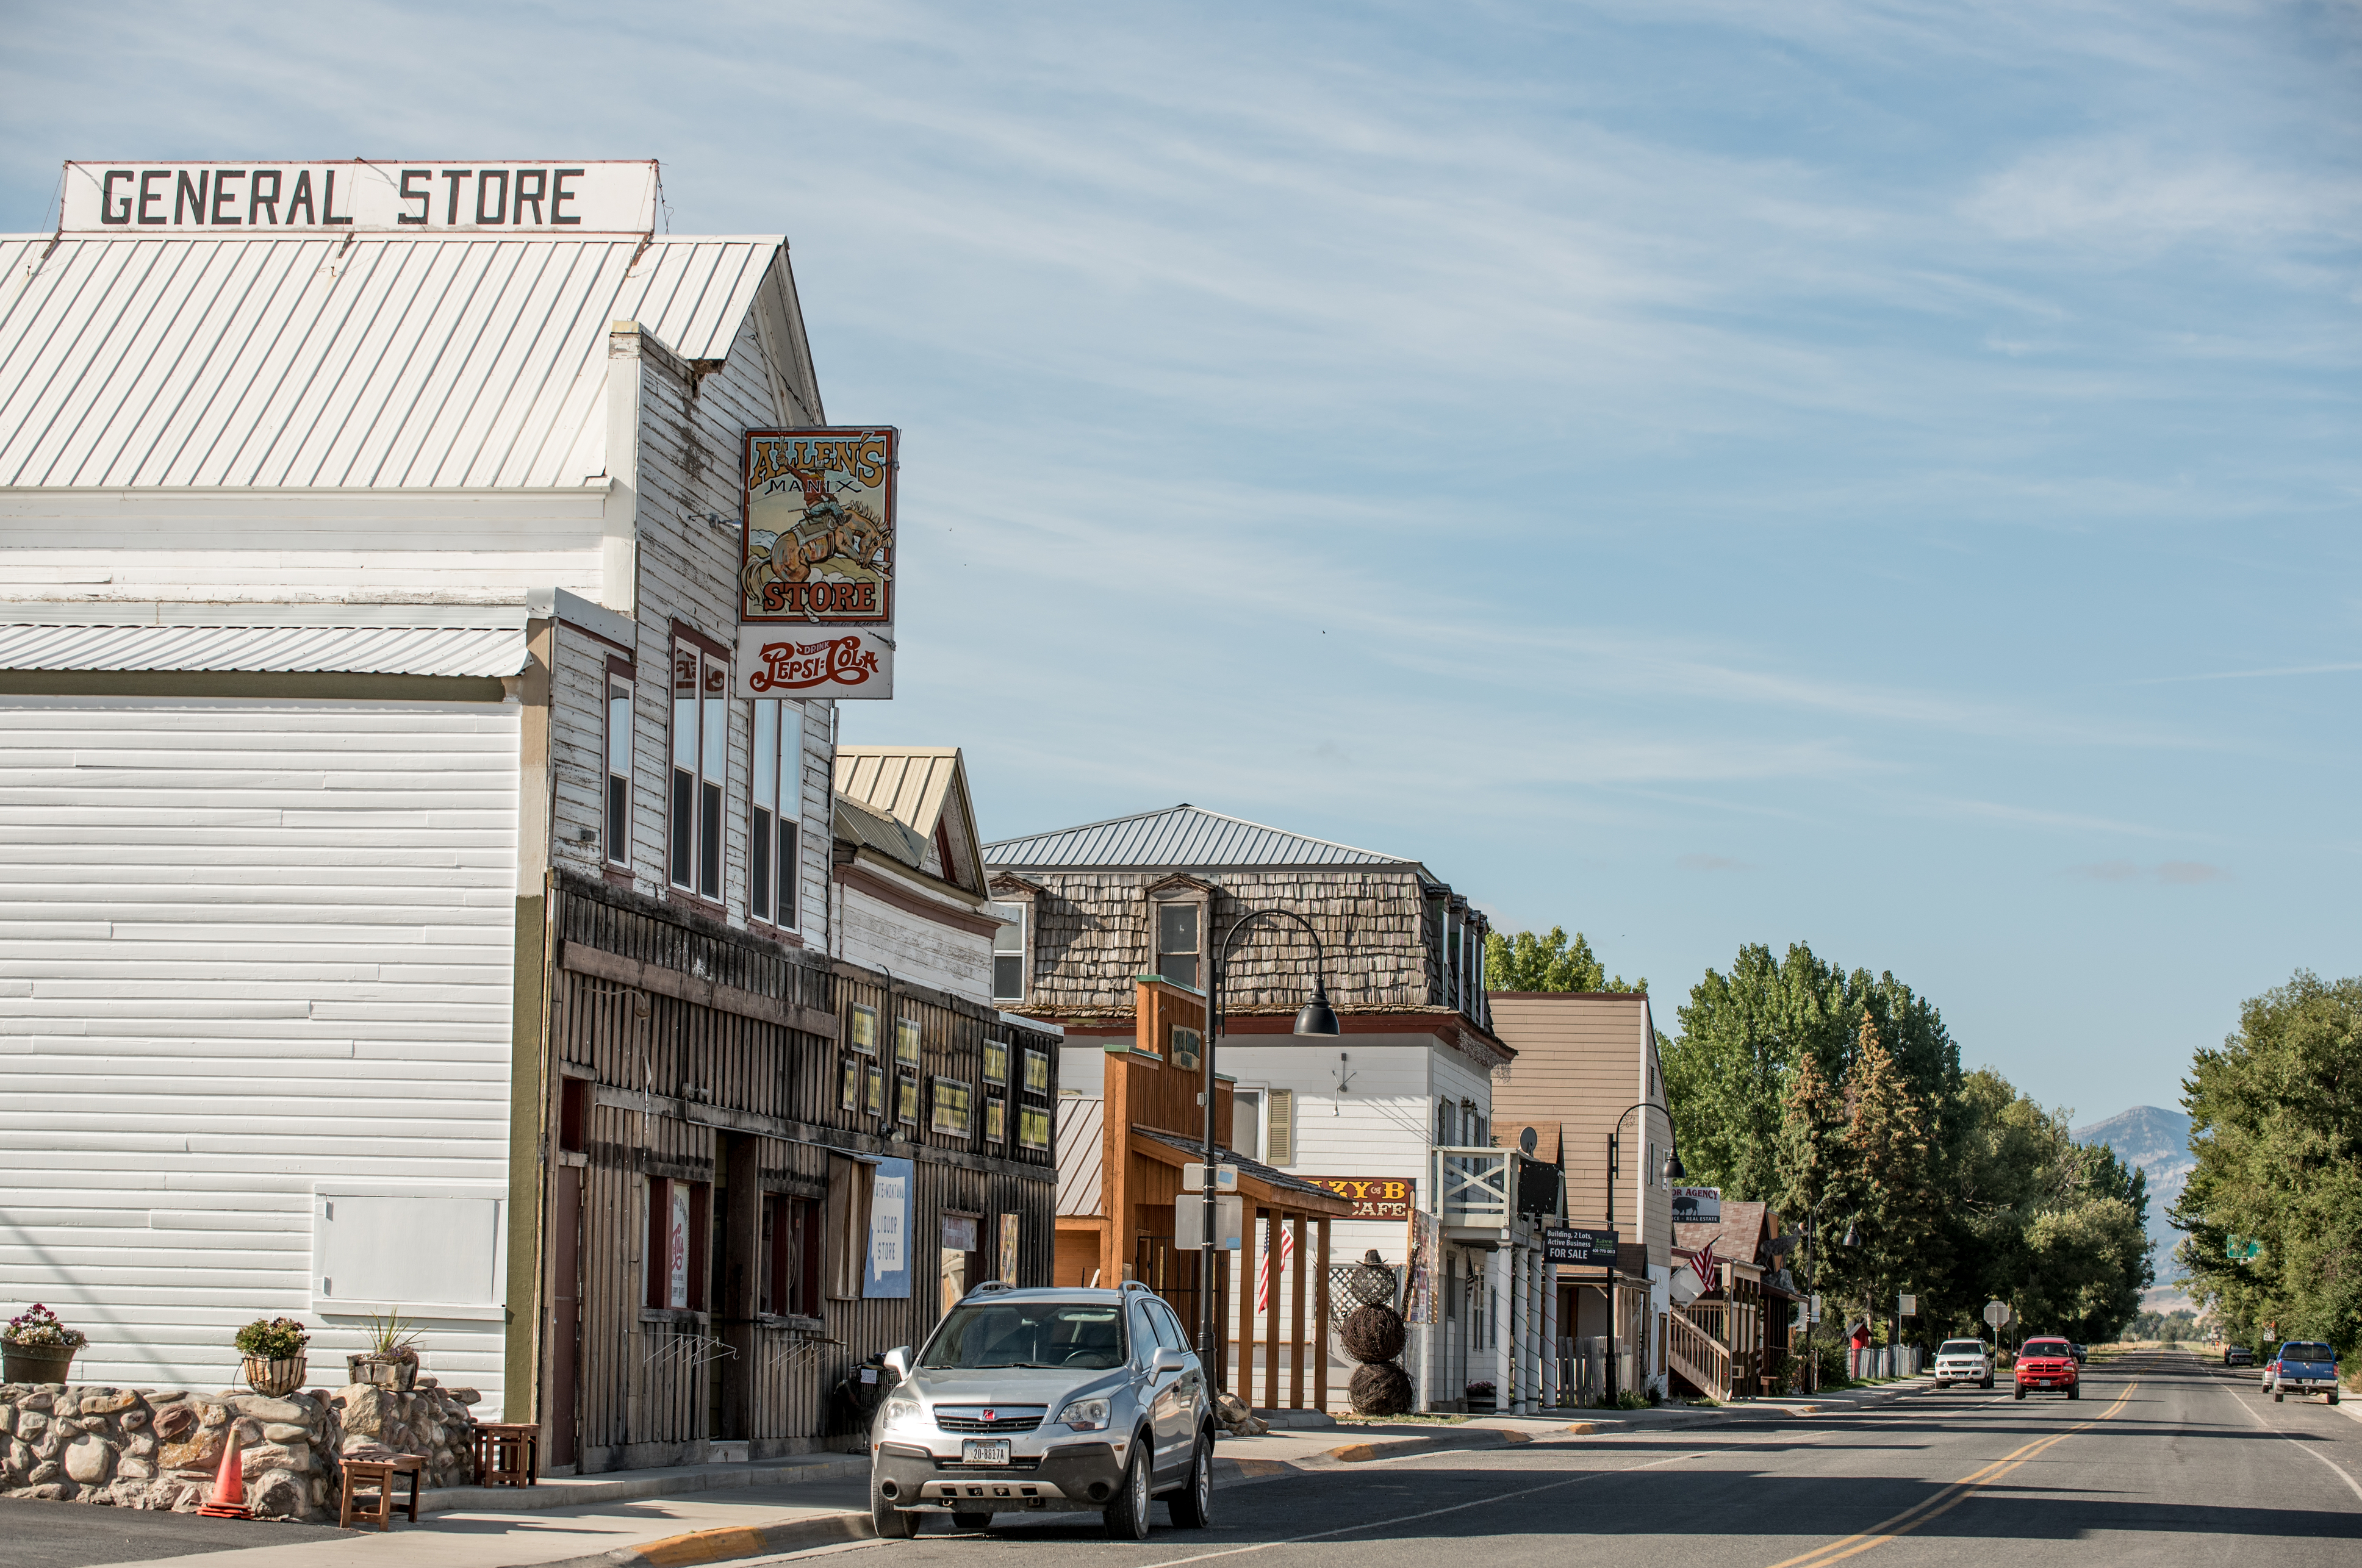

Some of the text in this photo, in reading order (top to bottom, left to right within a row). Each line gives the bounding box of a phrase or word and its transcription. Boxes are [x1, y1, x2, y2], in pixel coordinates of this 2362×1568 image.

[101, 168, 586, 226] GENERAL STORE
[750, 432, 885, 488] ALLEN'S
[764, 479, 862, 496] MANIX
[763, 582, 877, 612] STORE
[804, 641, 830, 654] DRINK
[985, 1047, 1005, 1079] SODA POP
[845, 1069, 854, 1103] ICE
[869, 1075, 880, 1108] BAIT
[900, 1084, 916, 1118] CANDY
[874, 1183, 884, 1198] TATE
[886, 1184, 904, 1200] MONTANA
[1382, 1181, 1405, 1199] B
[1685, 1188, 1718, 1200] AGENCY
[1352, 1202, 1406, 1217] CAFE
[877, 1215, 897, 1234] LIQUOR
[1547, 1230, 1573, 1239] Building,
[878, 1242, 895, 1260] STORE
[1550, 1248, 1587, 1259] FOR SALE
